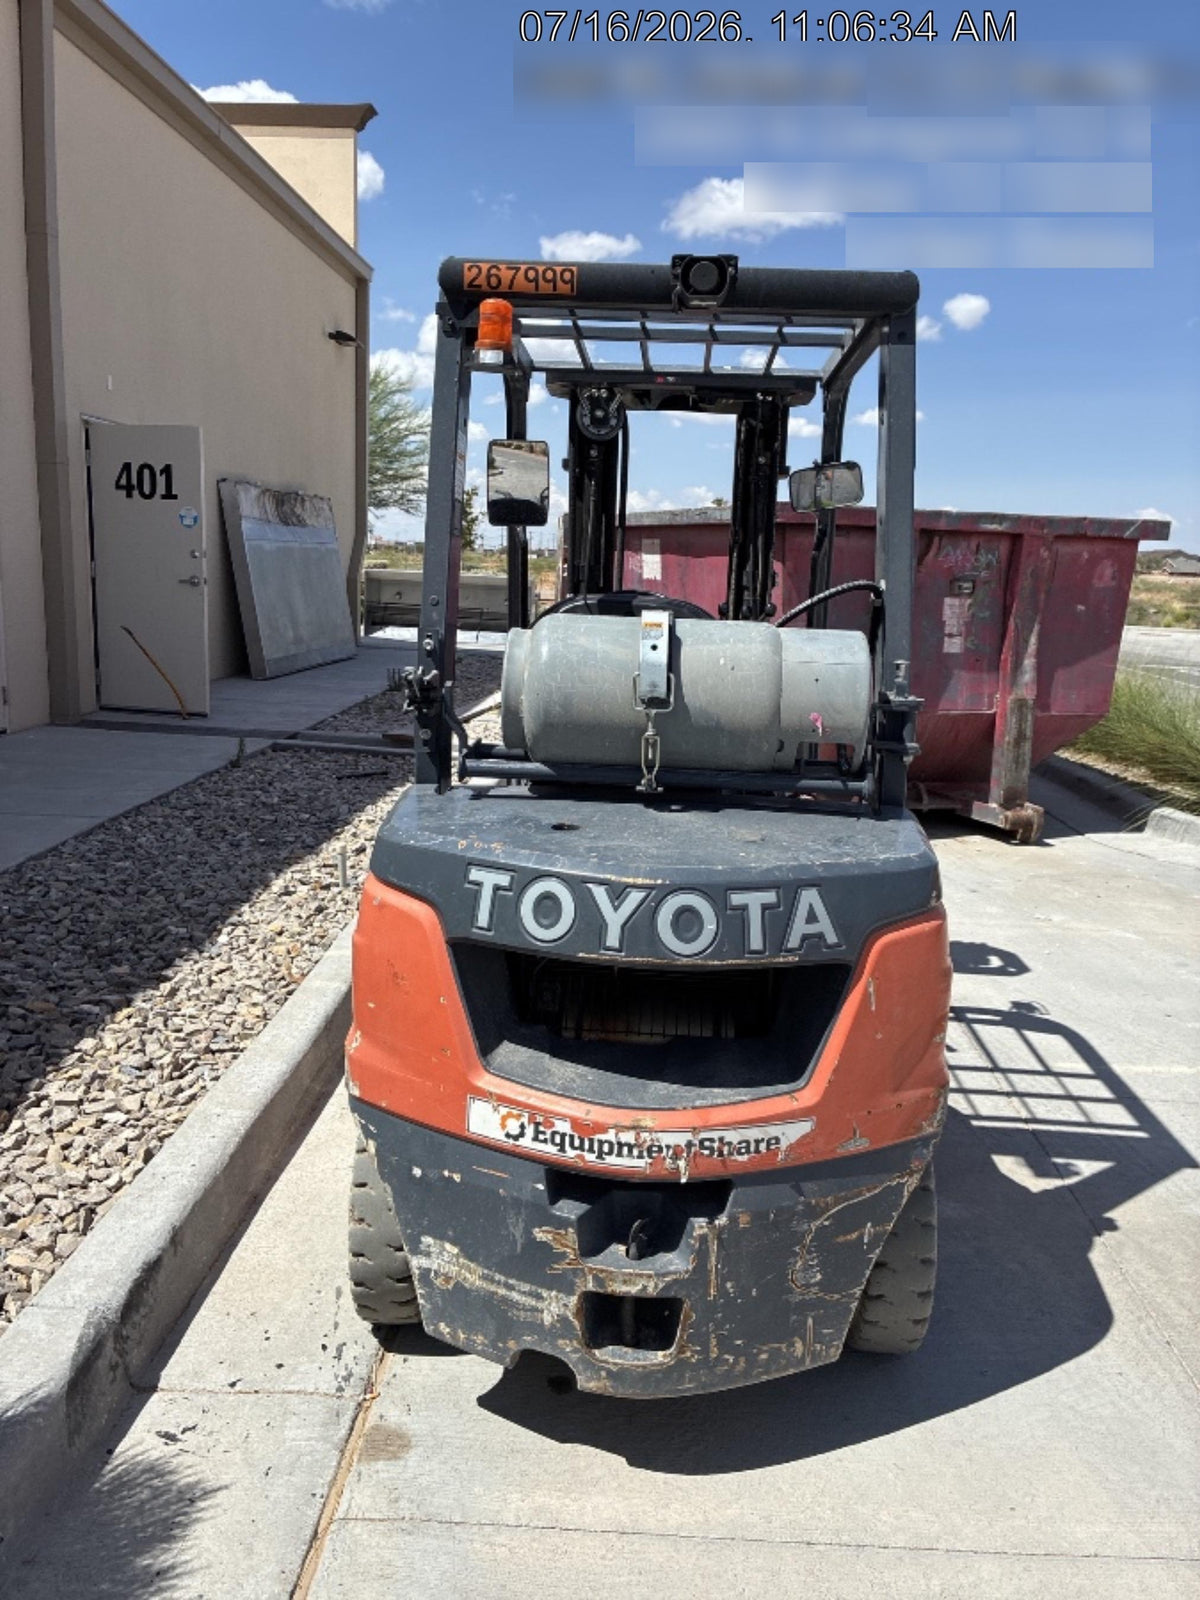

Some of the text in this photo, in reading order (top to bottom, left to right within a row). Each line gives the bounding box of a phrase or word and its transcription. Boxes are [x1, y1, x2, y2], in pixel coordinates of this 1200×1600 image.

[466, 264, 576, 295] 267999
[115, 462, 178, 500] 401
[467, 865, 840, 956] TOYOTA
